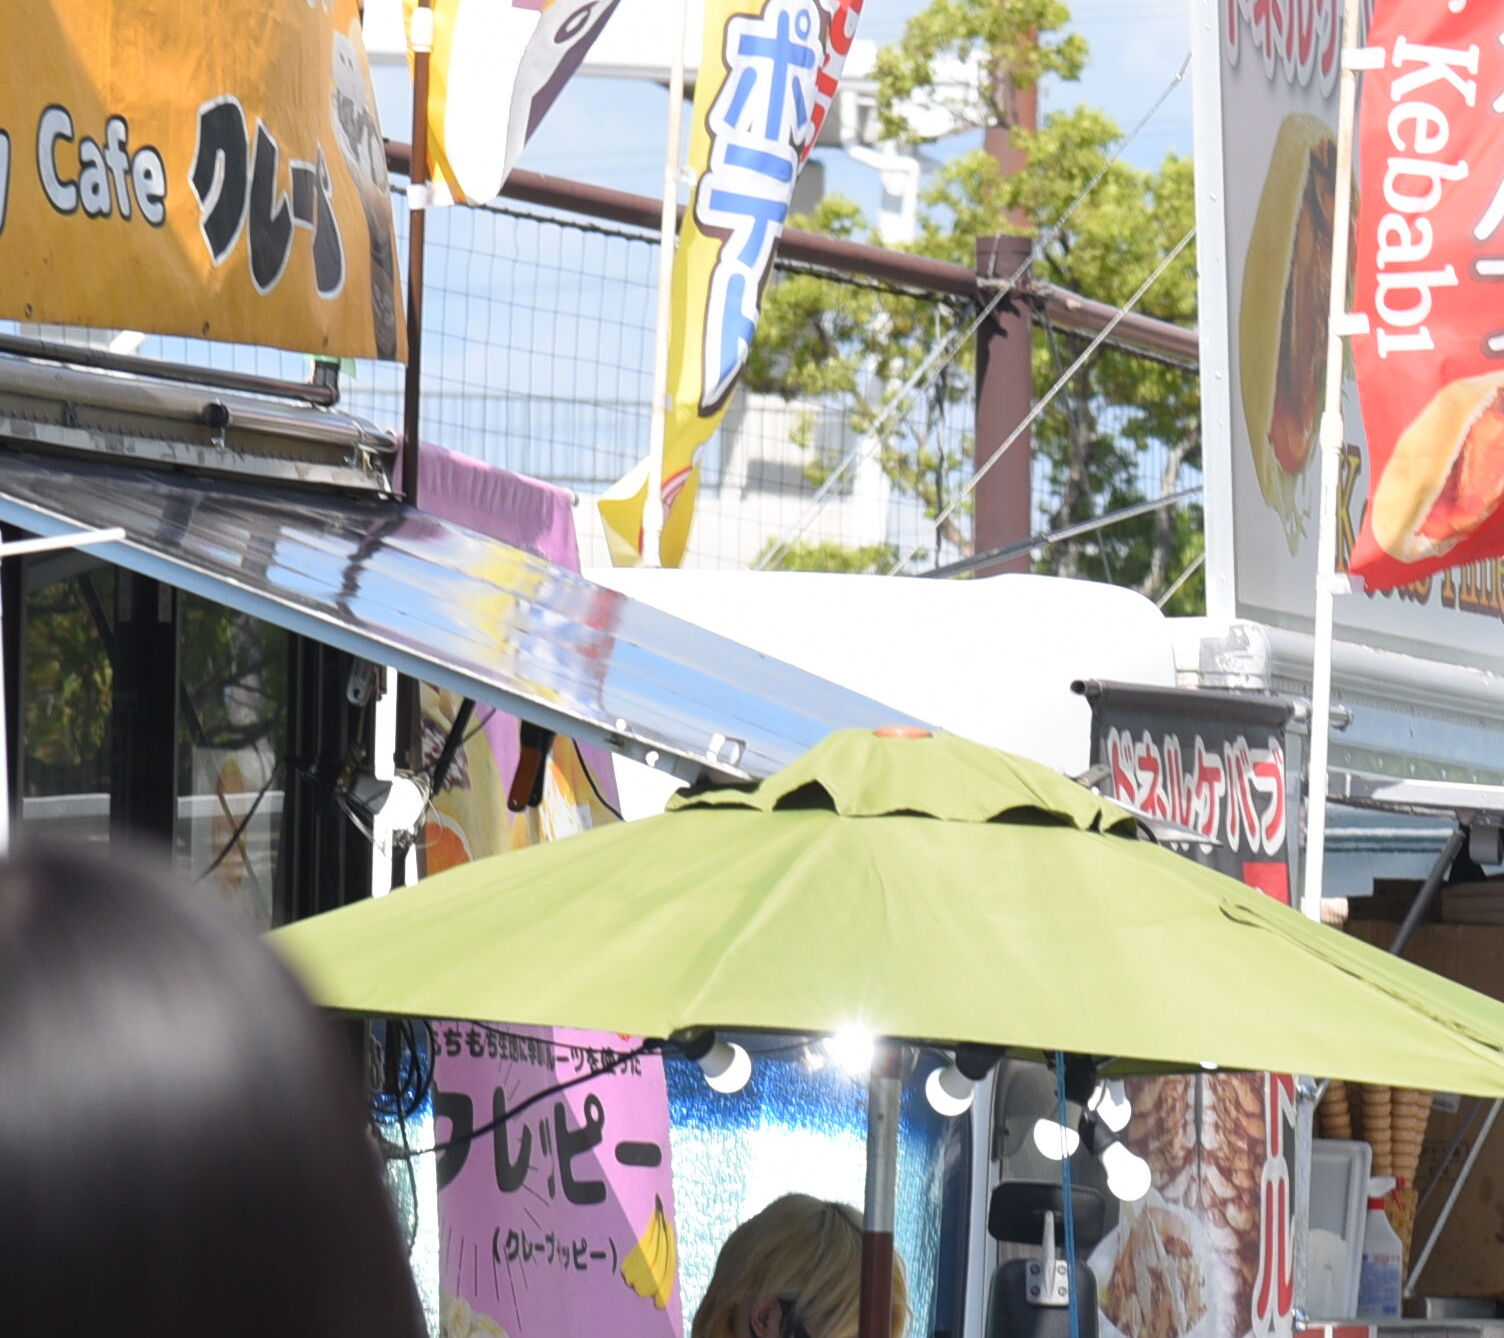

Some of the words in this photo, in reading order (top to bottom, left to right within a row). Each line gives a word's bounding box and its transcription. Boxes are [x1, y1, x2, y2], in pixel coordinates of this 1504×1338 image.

[36, 103, 167, 228] Cafe
[1107, 726, 1287, 857] ドネルケバブ
